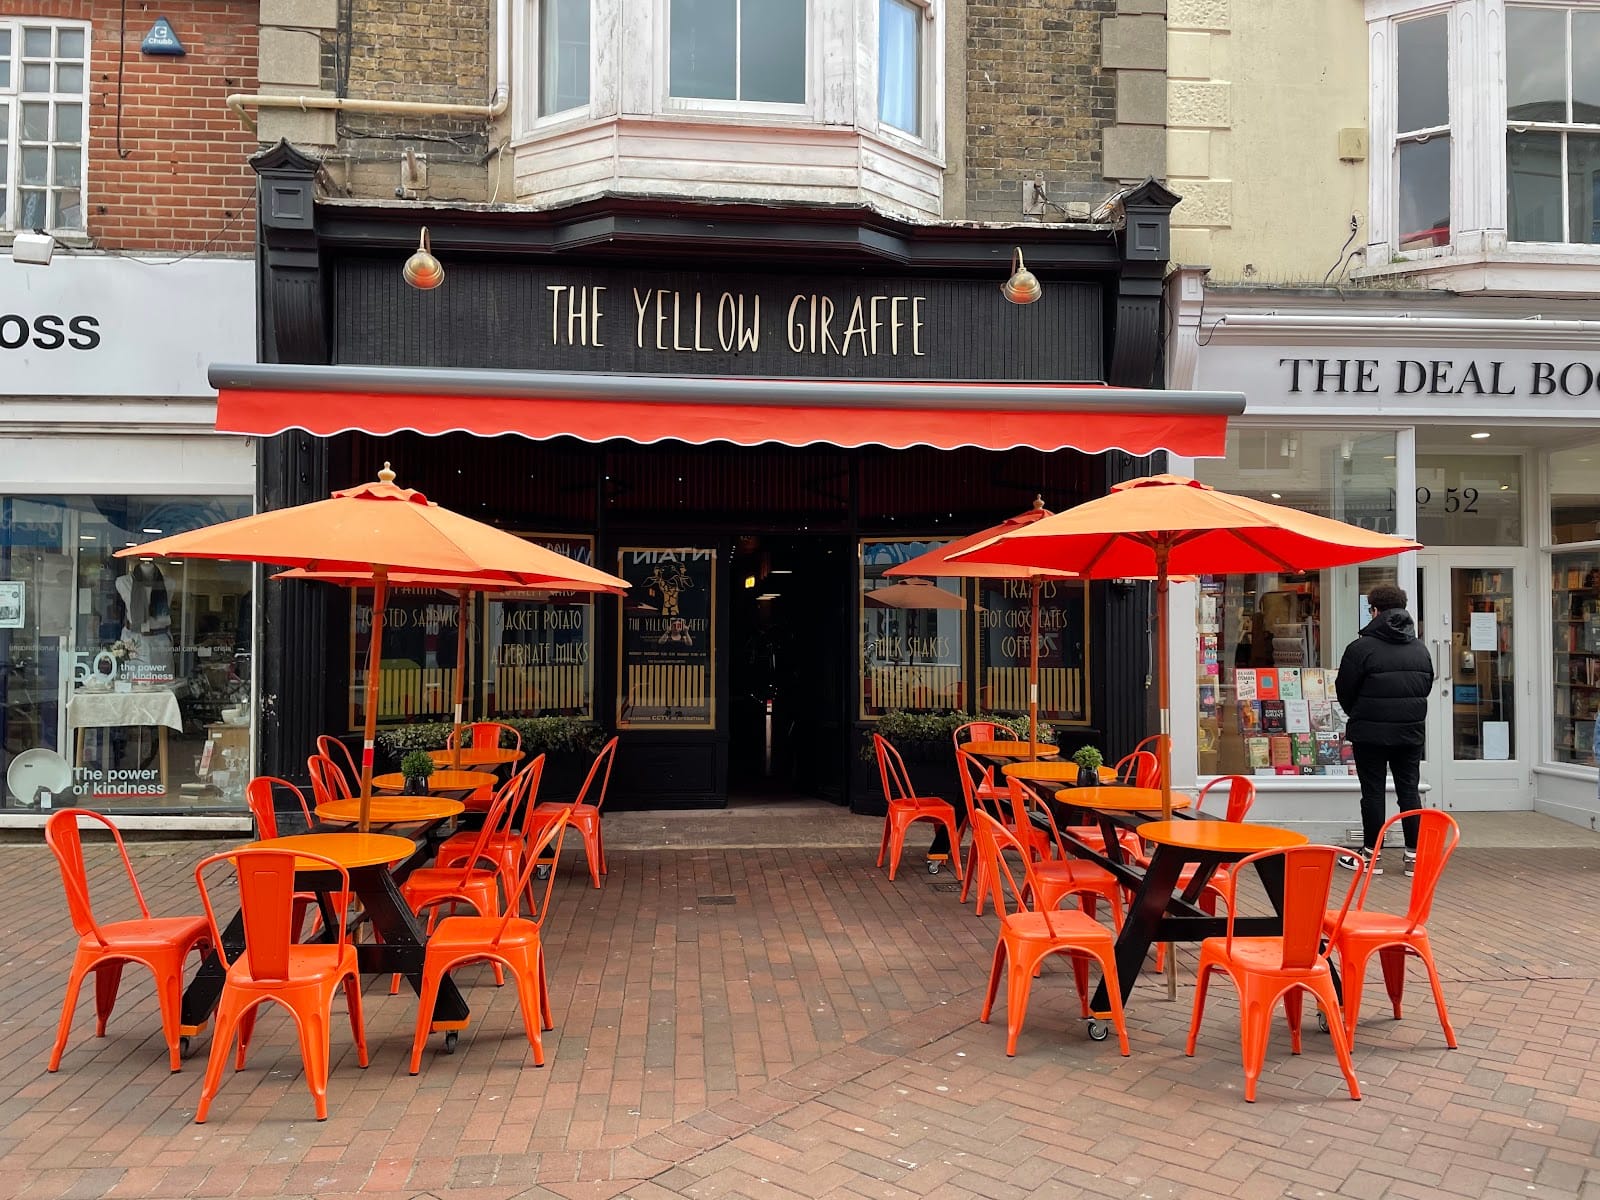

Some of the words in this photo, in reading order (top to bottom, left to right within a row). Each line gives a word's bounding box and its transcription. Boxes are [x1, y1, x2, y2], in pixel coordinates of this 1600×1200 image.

[546, 285, 607, 347] THE
[633, 287, 760, 352] YELLOW
[787, 294, 927, 357] GIRAFFE
[0, 314, 101, 350] OSS
[1279, 359, 1380, 393] THE
[1394, 360, 1516, 395] DEAL
[1528, 362, 1600, 396] BO
[1444, 487, 1479, 515] 52
[360, 607, 408, 628] TOSTED
[412, 607, 461, 628] SANDWIC
[496, 610, 540, 631] JACKET
[543, 610, 582, 630] POTATO
[983, 609, 1002, 628] HOT
[1004, 609, 1068, 629] CHOCLATES
[490, 642, 551, 665] ALTERNATE
[555, 642, 589, 664] MILKS
[875, 636, 903, 657] MILK
[907, 636, 950, 658] SHAKES
[120, 663, 136, 672] the
[137, 664, 167, 674] power
[120, 672, 130, 680] of
[132, 672, 174, 680] kindness
[73, 767, 103, 780] The
[107, 769, 158, 783] power
[72, 782, 89, 795] of
[93, 782, 166, 795] kindness
